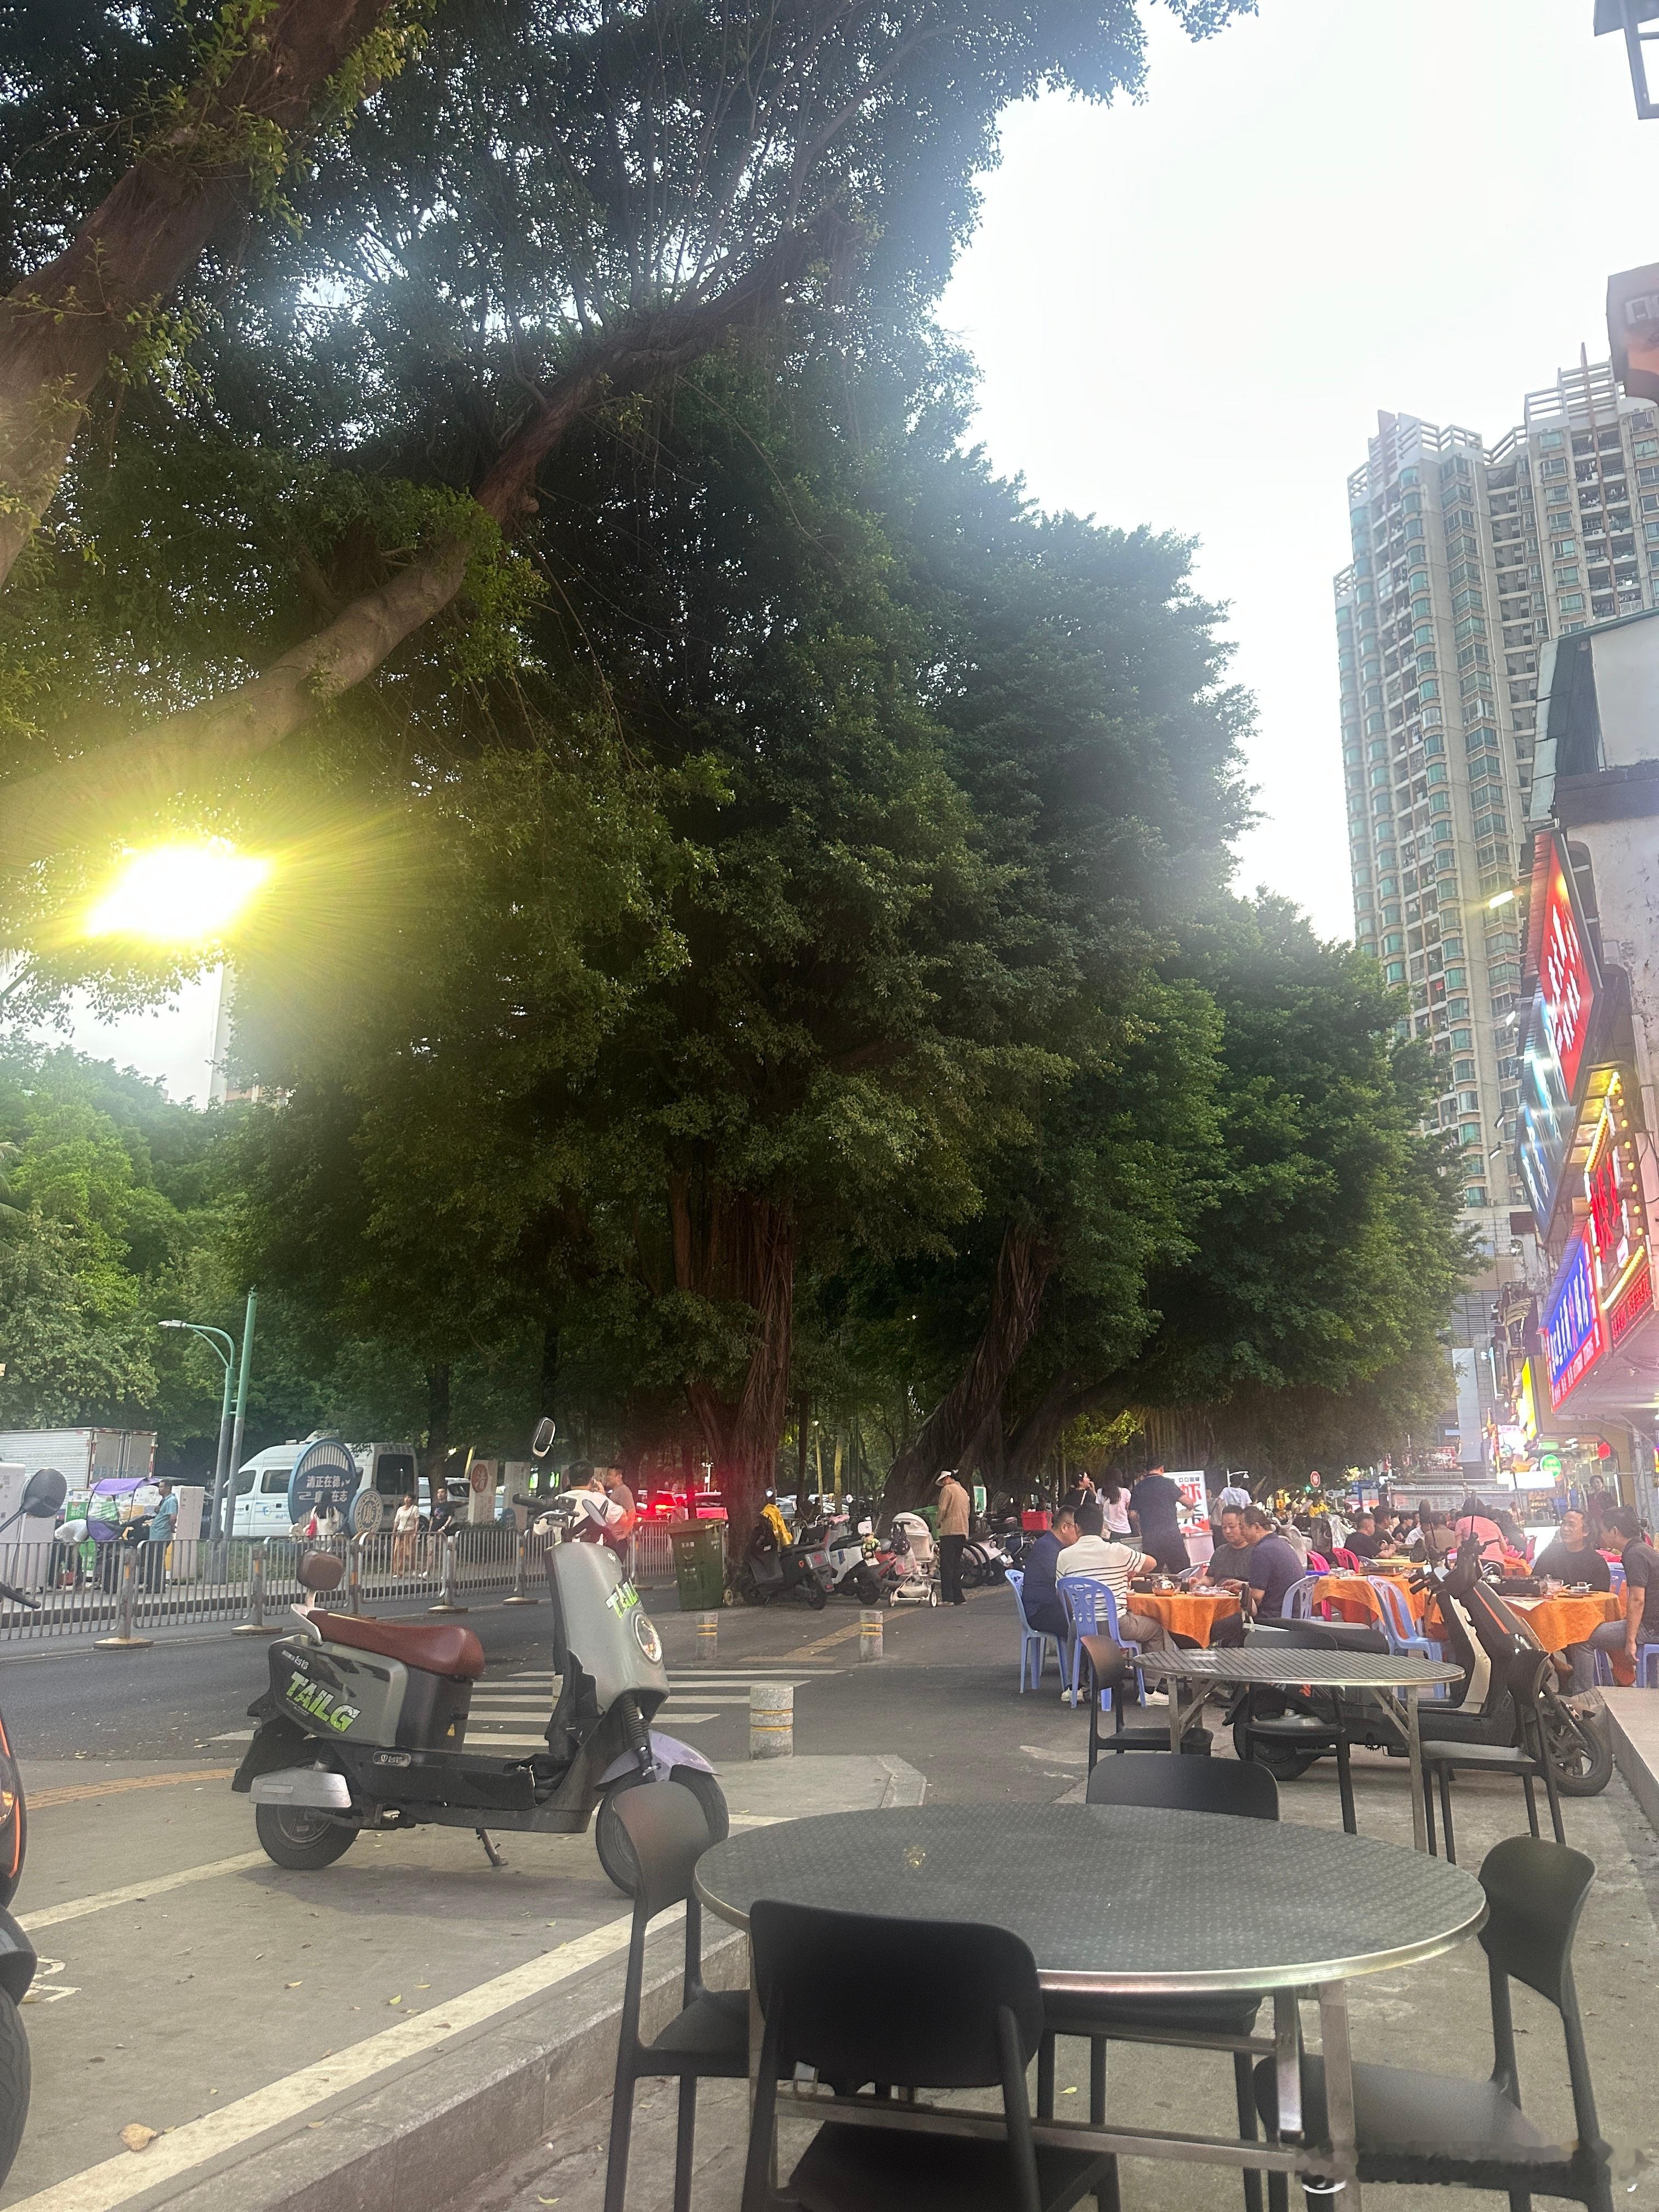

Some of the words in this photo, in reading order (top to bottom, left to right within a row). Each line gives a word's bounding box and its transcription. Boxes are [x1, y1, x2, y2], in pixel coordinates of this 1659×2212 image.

[307, 1475, 341, 1488] 清正在德
[314, 1490, 348, 1503] 廉在志
[286, 1671, 362, 1732] TAILG
